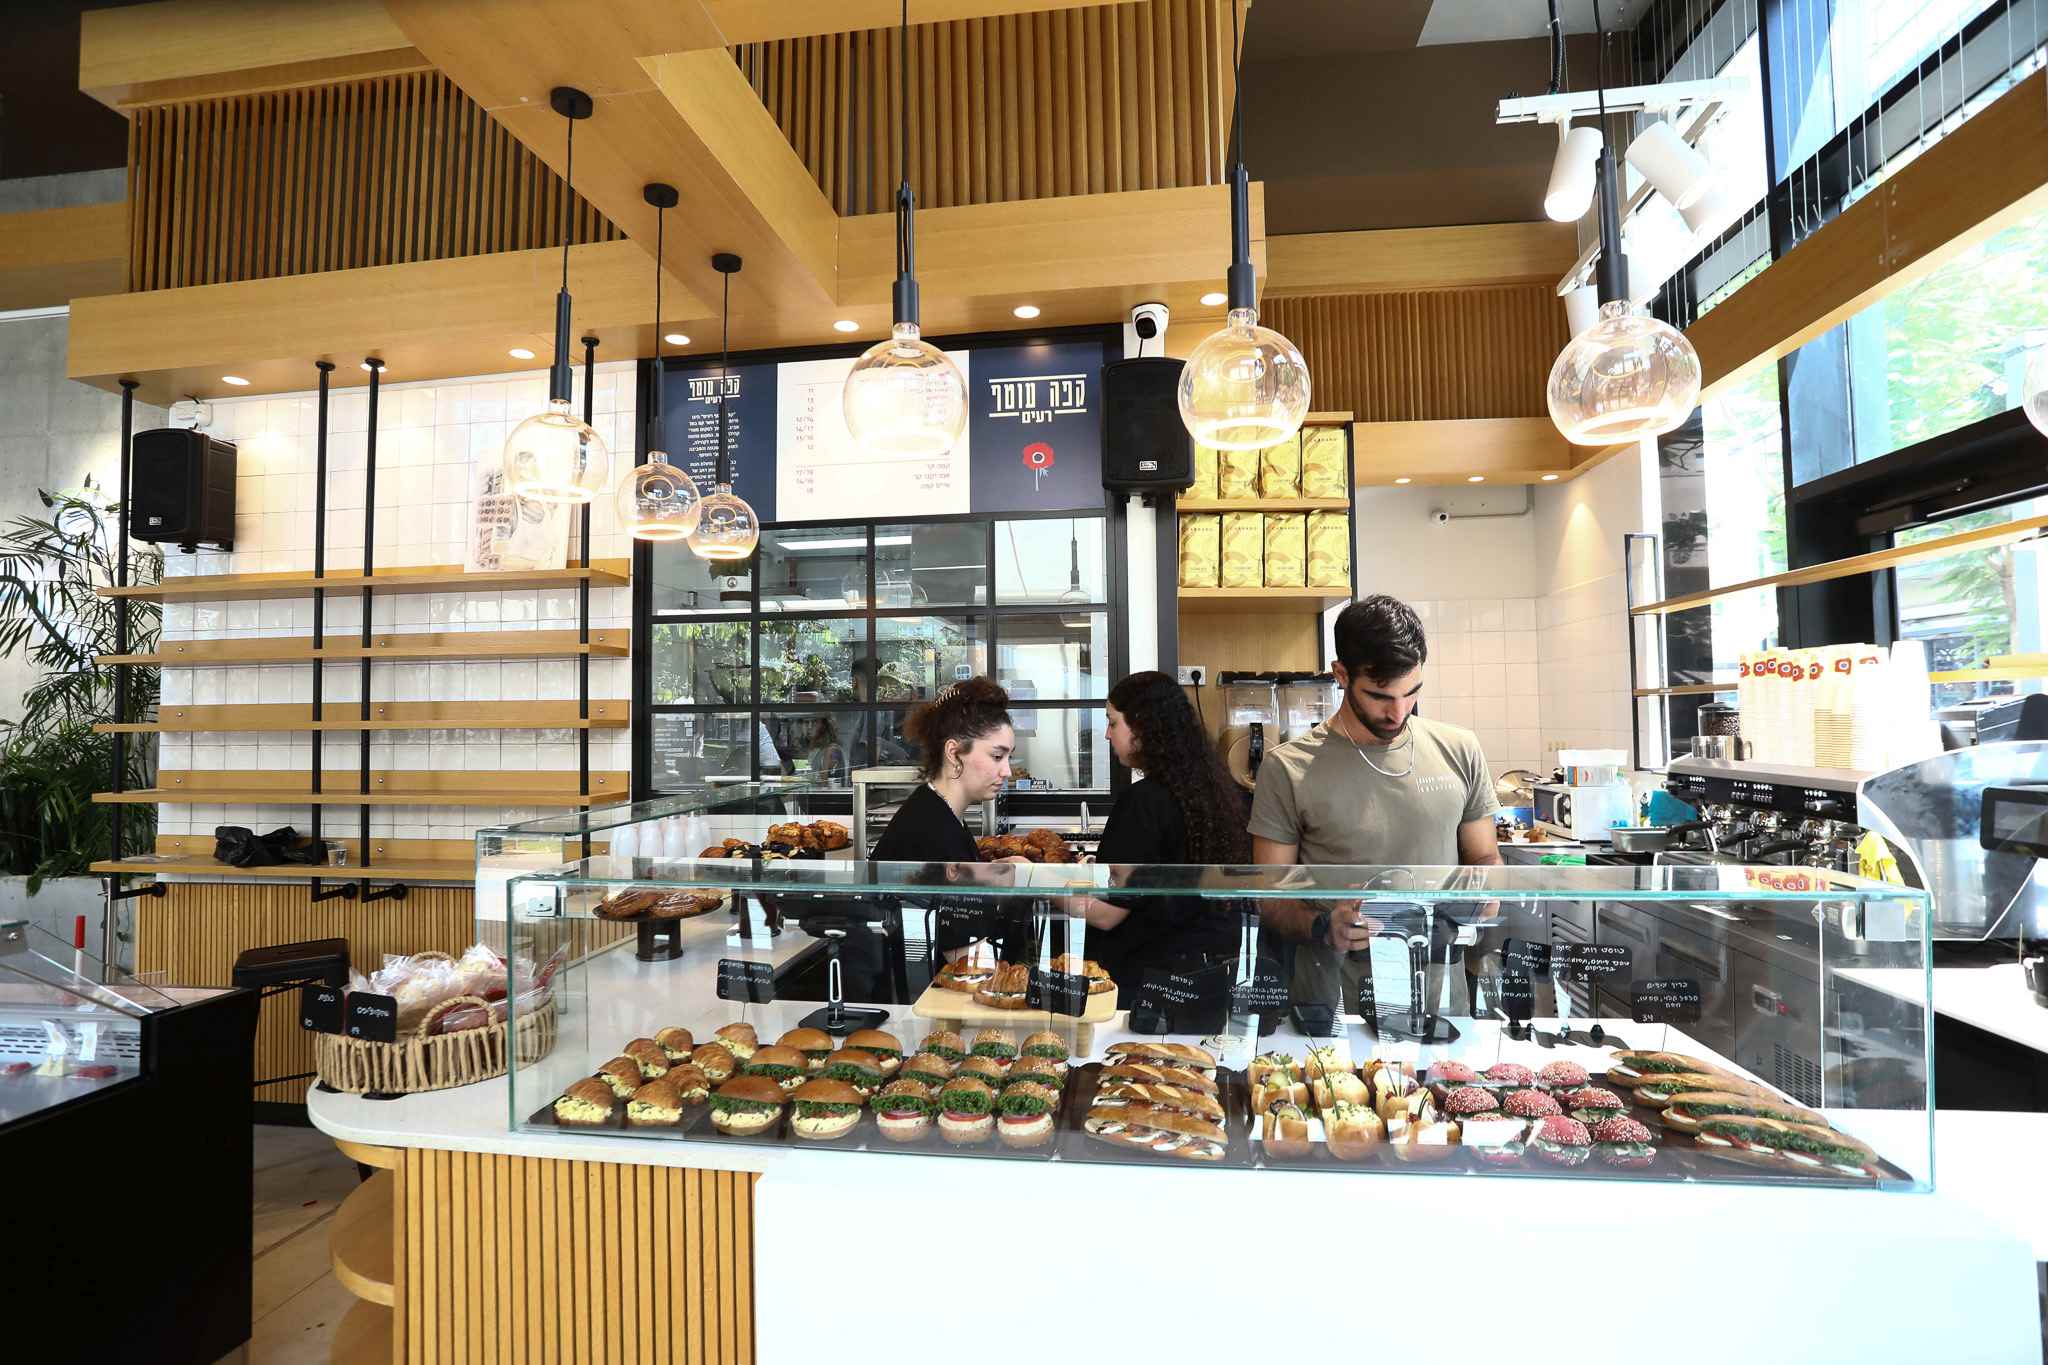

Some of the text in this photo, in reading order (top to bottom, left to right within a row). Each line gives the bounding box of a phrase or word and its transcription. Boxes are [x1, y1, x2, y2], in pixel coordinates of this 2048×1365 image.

[689, 381, 713, 397] עוטף
[991, 379, 1085, 412] קפה עוטף
[704, 396, 721, 404] רעים
[1022, 410, 1052, 423] רעים
